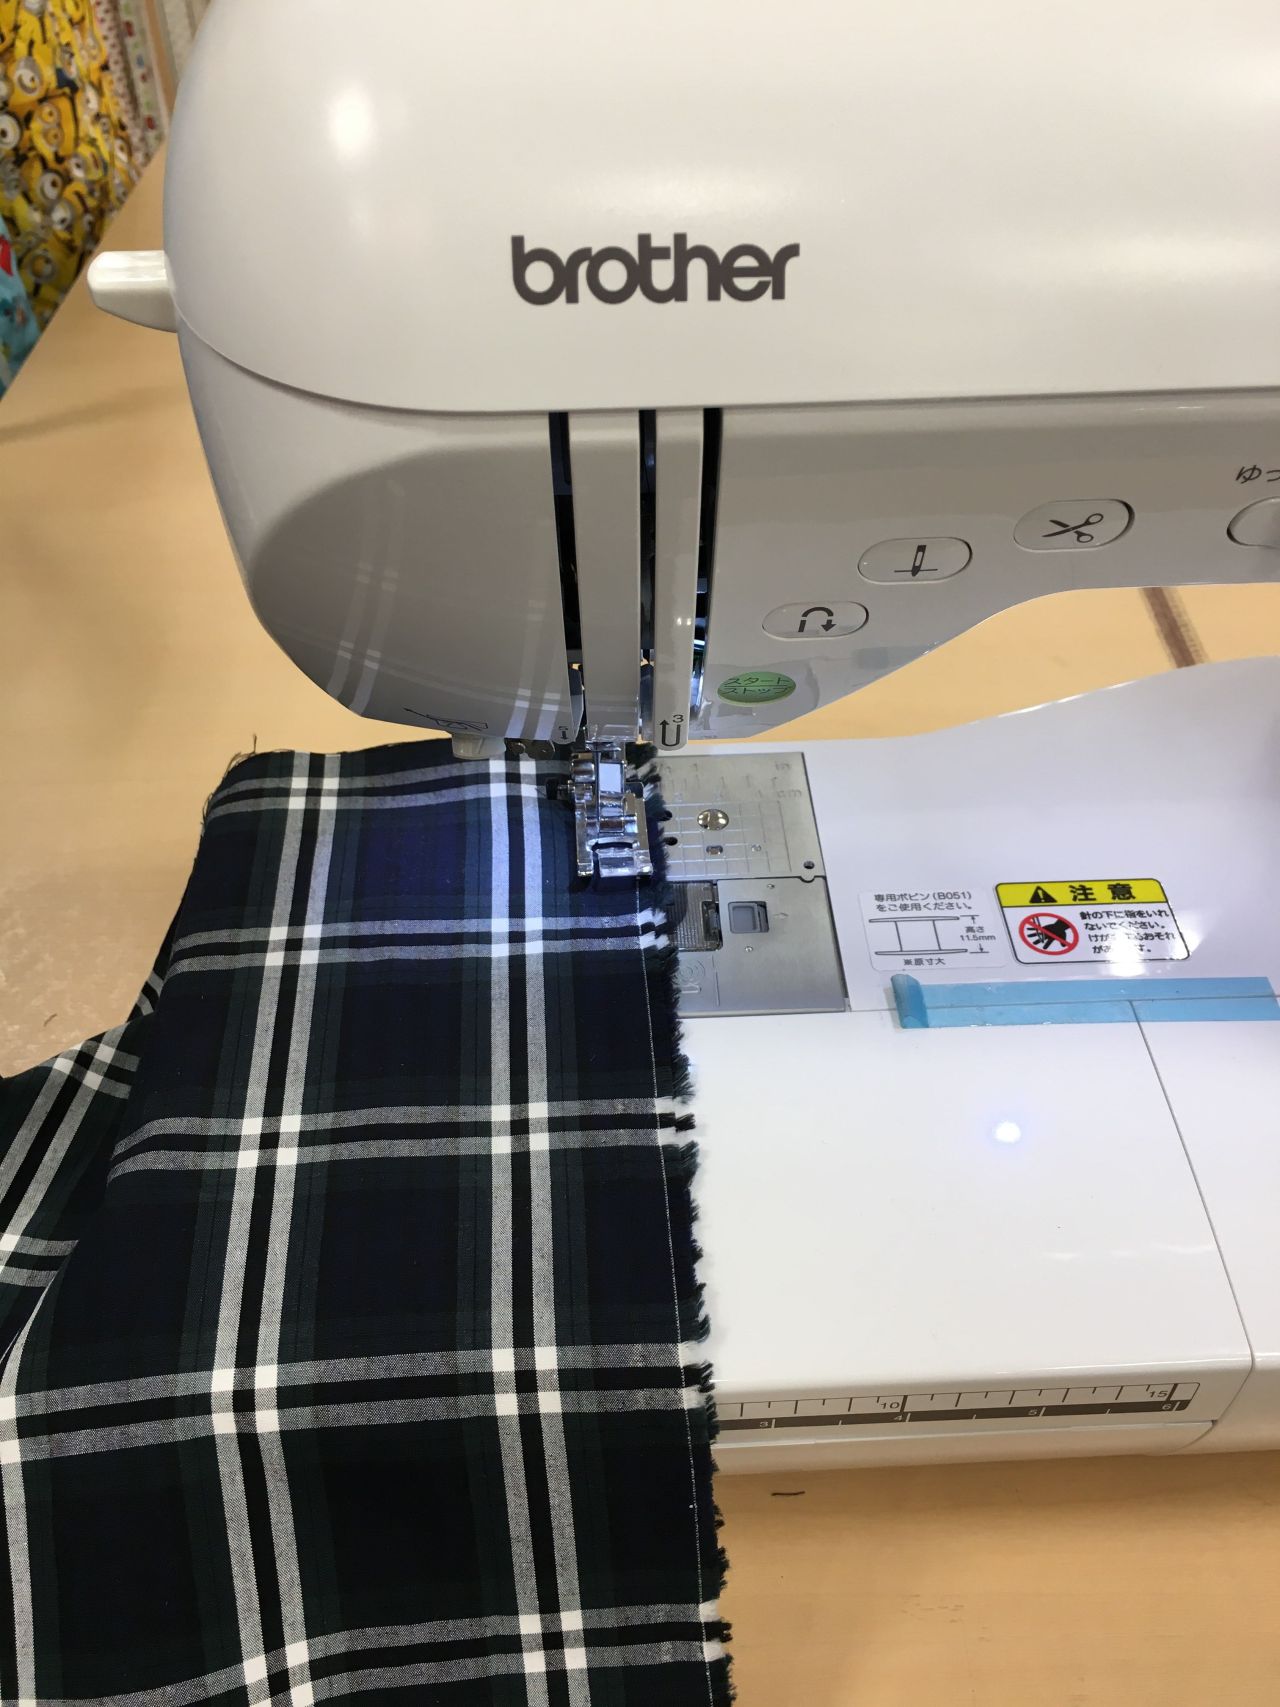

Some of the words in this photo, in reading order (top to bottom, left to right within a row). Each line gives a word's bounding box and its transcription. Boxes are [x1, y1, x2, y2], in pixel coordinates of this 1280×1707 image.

[511, 232, 800, 306] brother
[723, 677, 790, 686] スタート
[721, 687, 789, 695] ストップ
[672, 714, 684, 723] 3
[1068, 883, 1136, 902] 注意
[1079, 909, 1169, 920] 針の下に指をいれ
[880, 1401, 900, 1410] 10
[1150, 1390, 1168, 1398] 15
